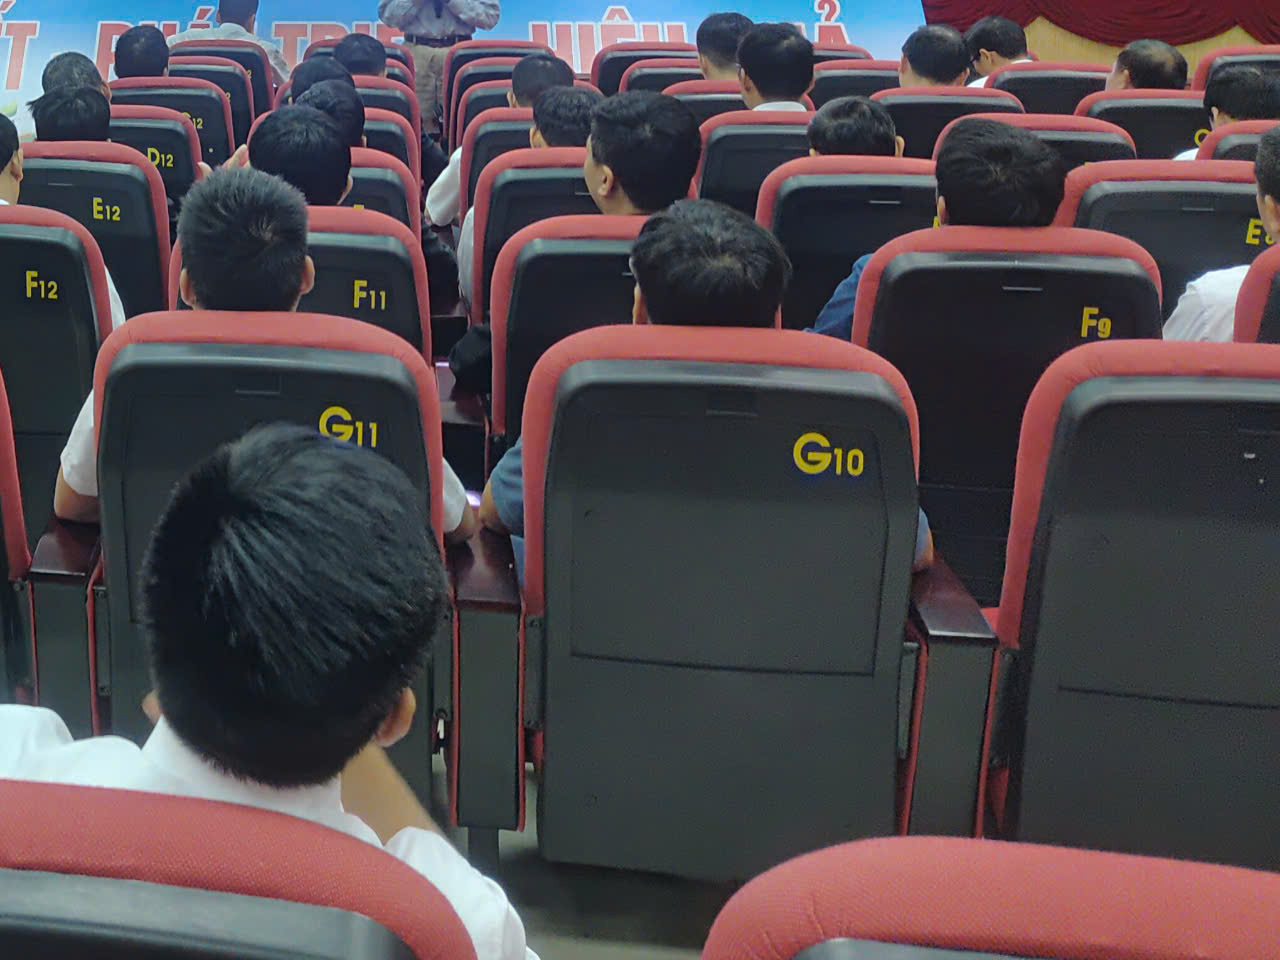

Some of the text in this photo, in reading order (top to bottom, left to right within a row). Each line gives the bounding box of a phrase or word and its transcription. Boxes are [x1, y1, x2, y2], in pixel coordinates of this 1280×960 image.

[147, 147, 174, 167] D12
[93, 196, 121, 221] E12
[26, 270, 58, 299] F12
[353, 280, 387, 310] F11
[1080, 306, 1113, 339] F9
[319, 406, 378, 448] G11
[793, 431, 865, 477] G10
